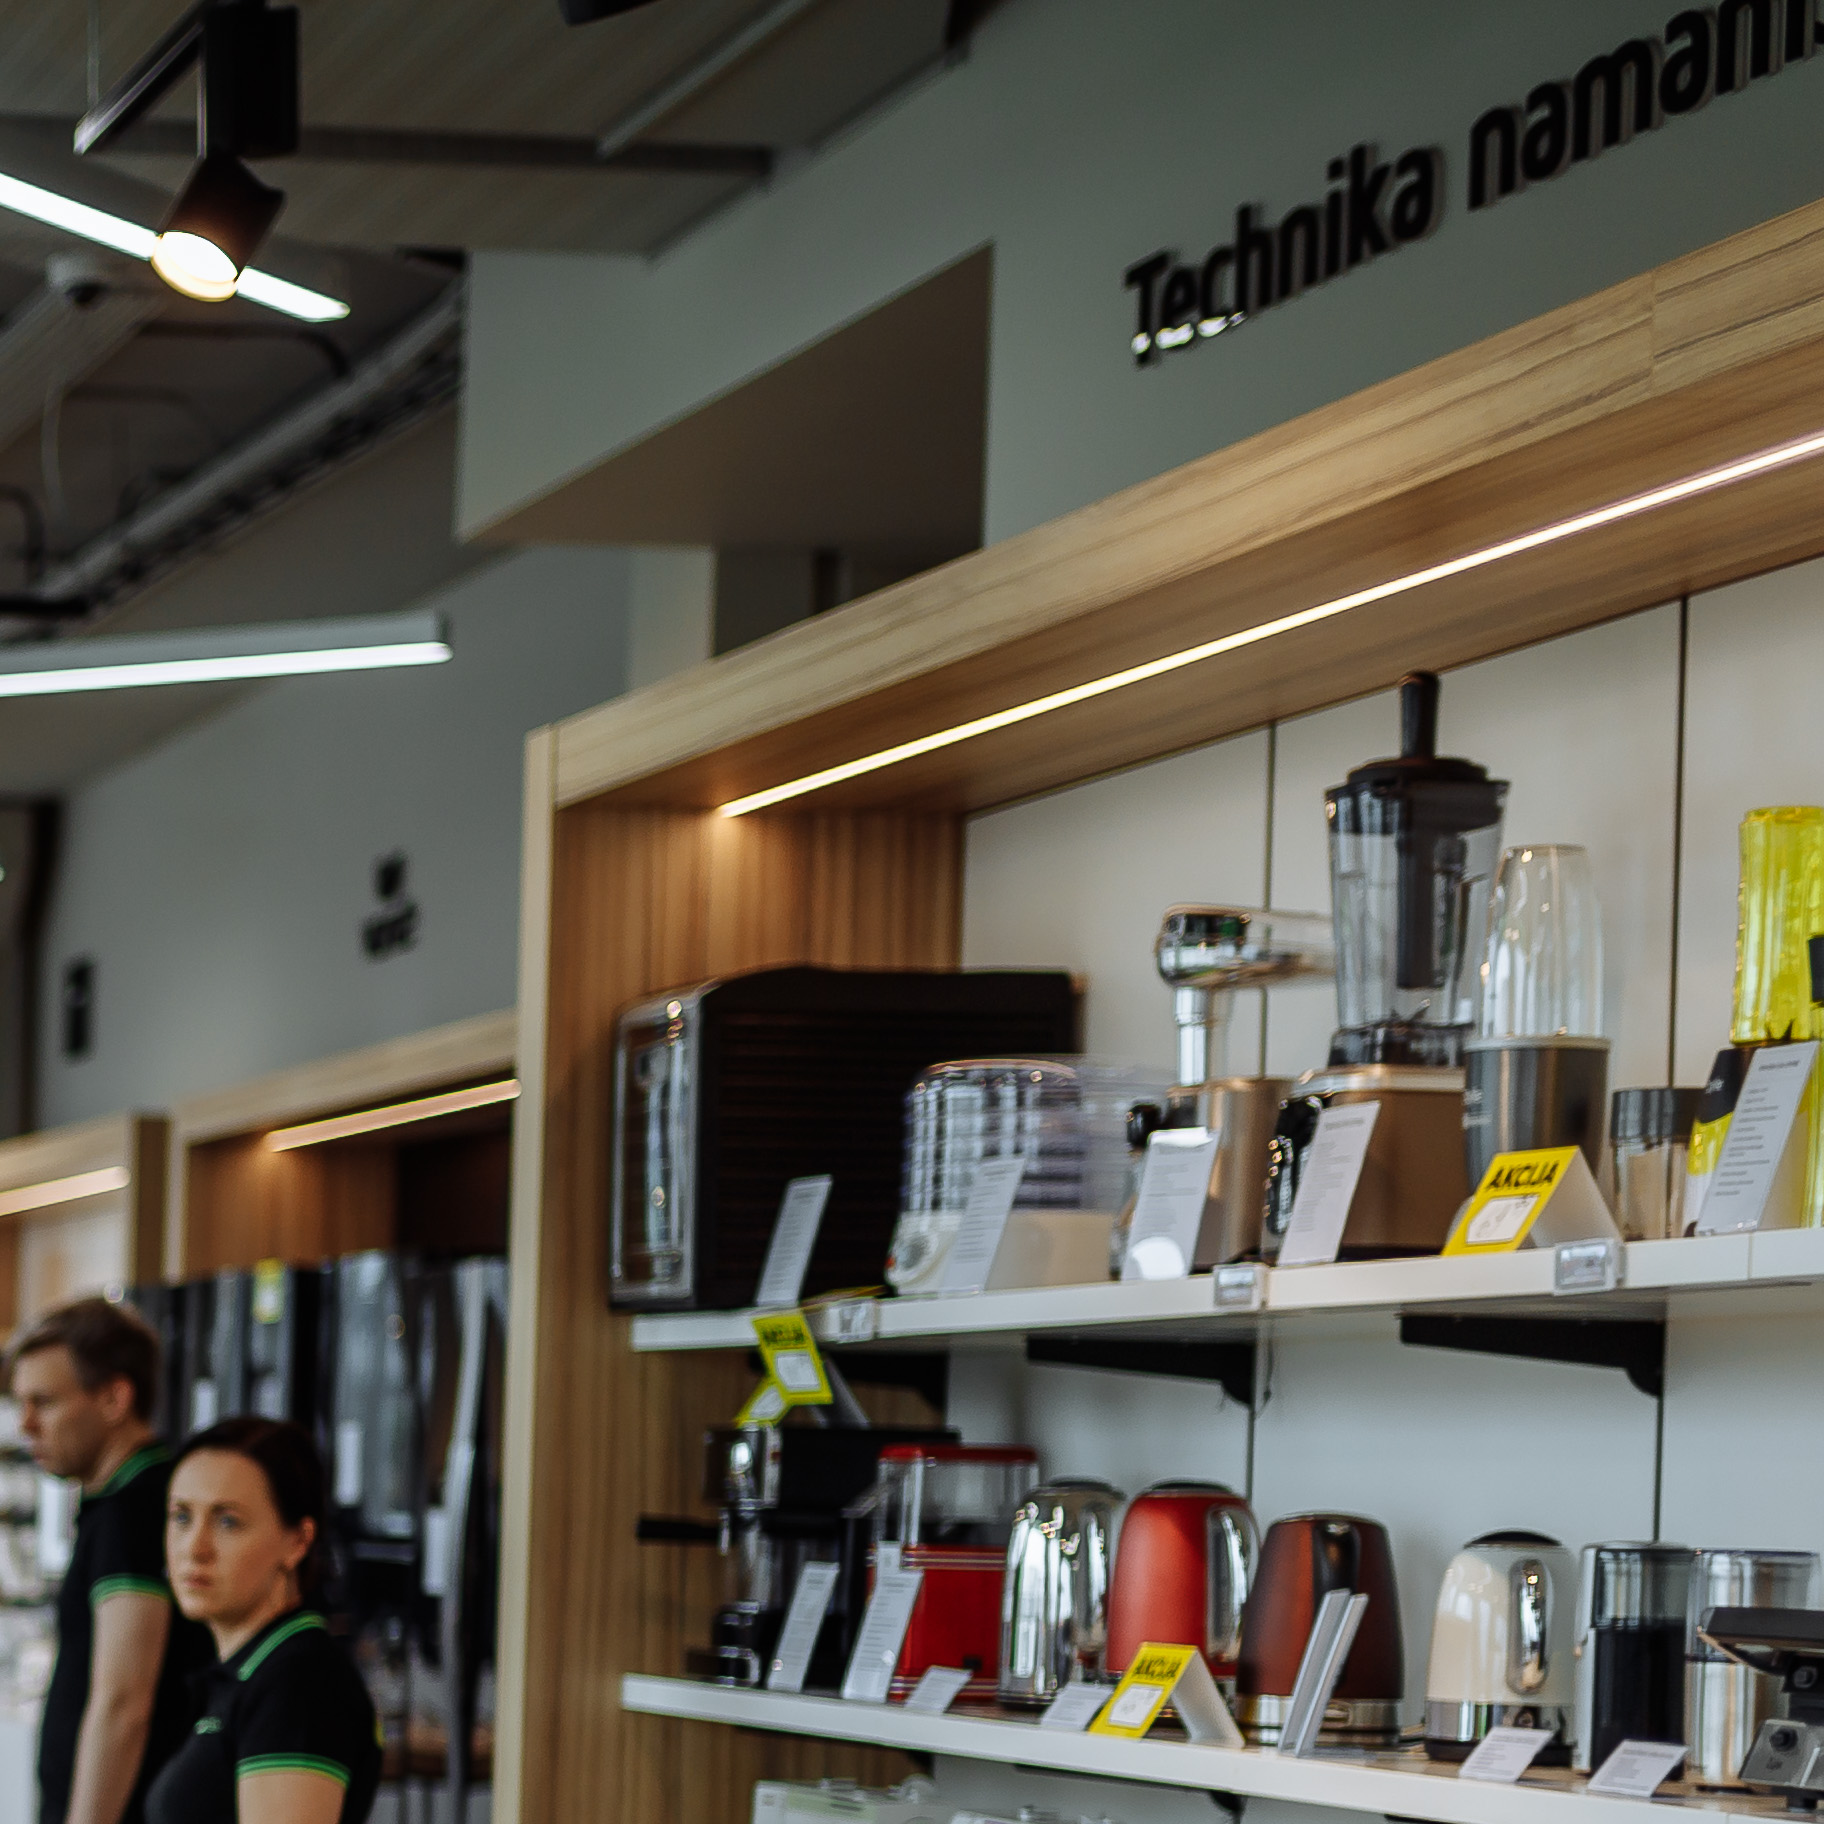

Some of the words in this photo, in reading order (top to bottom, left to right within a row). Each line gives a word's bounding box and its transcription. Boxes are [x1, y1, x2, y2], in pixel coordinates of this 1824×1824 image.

[1124, 142, 1446, 369] Technika
[1467, 0, 1824, 212] namam
[1484, 1159, 1560, 1193] AKCIJA
